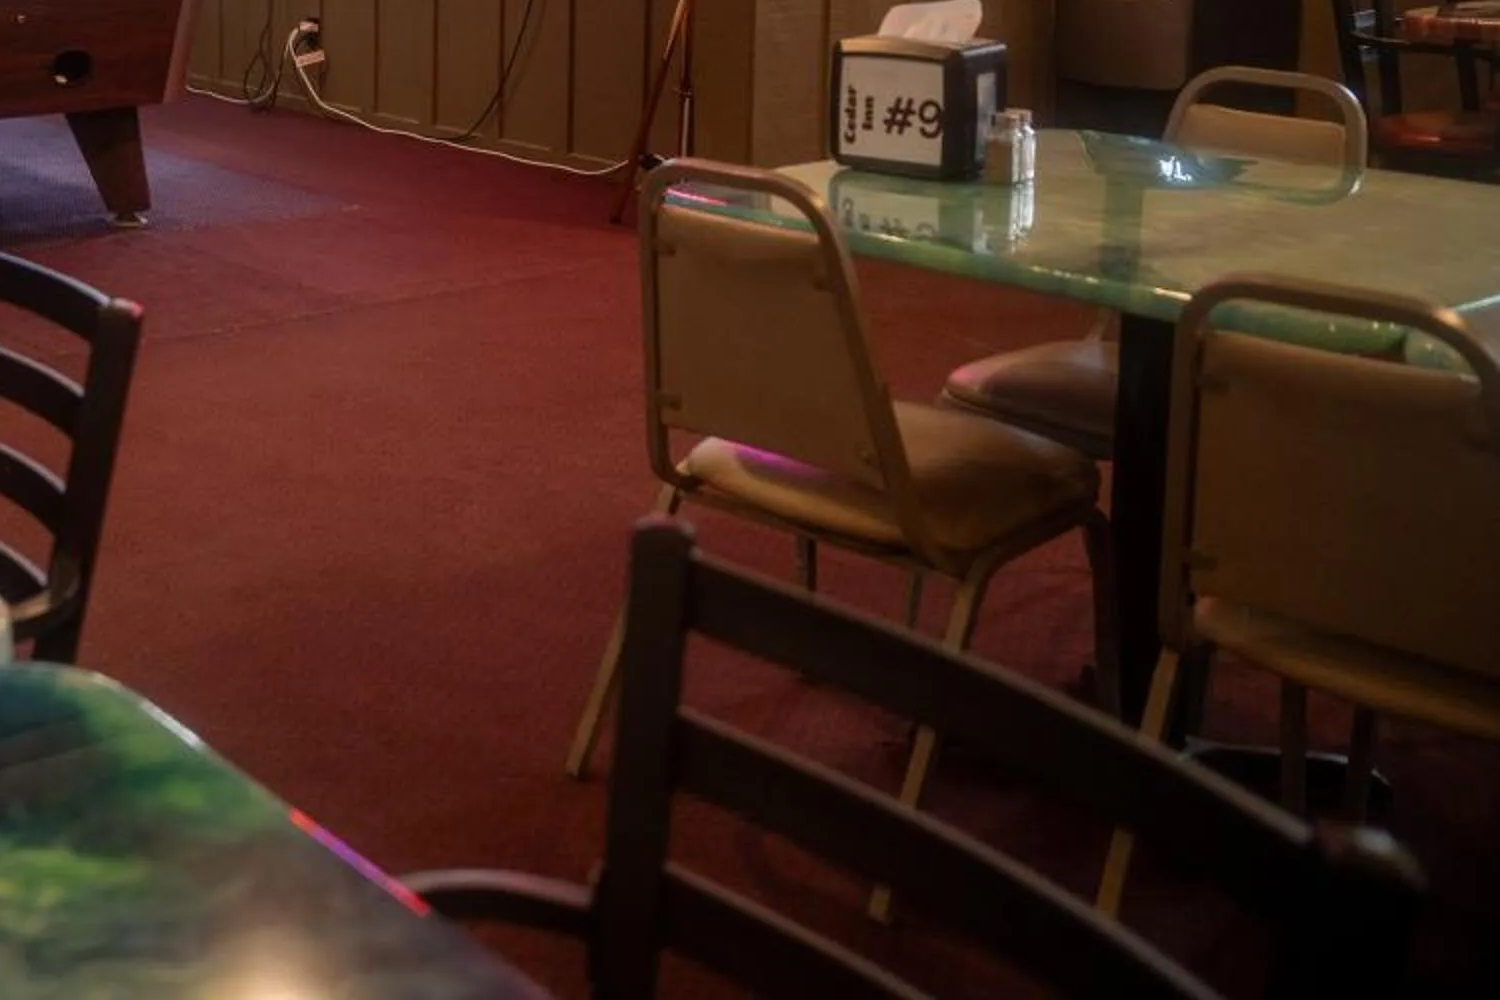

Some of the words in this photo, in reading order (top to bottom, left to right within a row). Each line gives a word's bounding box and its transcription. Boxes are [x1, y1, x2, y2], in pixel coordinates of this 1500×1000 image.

[844, 86, 857, 144] Cedar
[862, 95, 875, 131] Inn
[882, 97, 943, 139] #9
